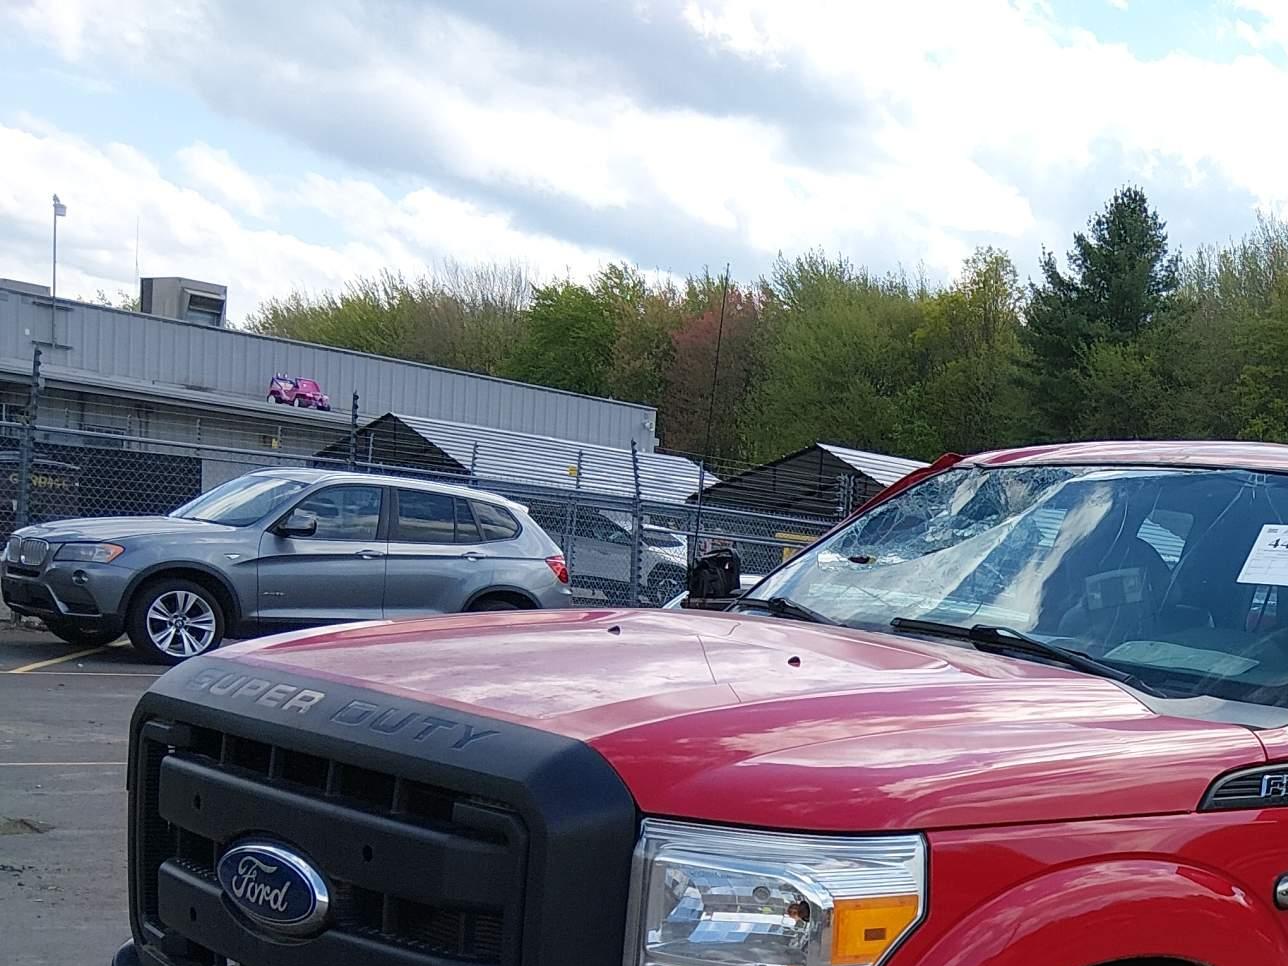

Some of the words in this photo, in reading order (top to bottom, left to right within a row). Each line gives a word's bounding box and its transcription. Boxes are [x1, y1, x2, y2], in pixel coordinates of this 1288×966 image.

[191, 668, 326, 714] SUPER
[330, 700, 500, 751] DUTY
[232, 856, 291, 911] Ford
